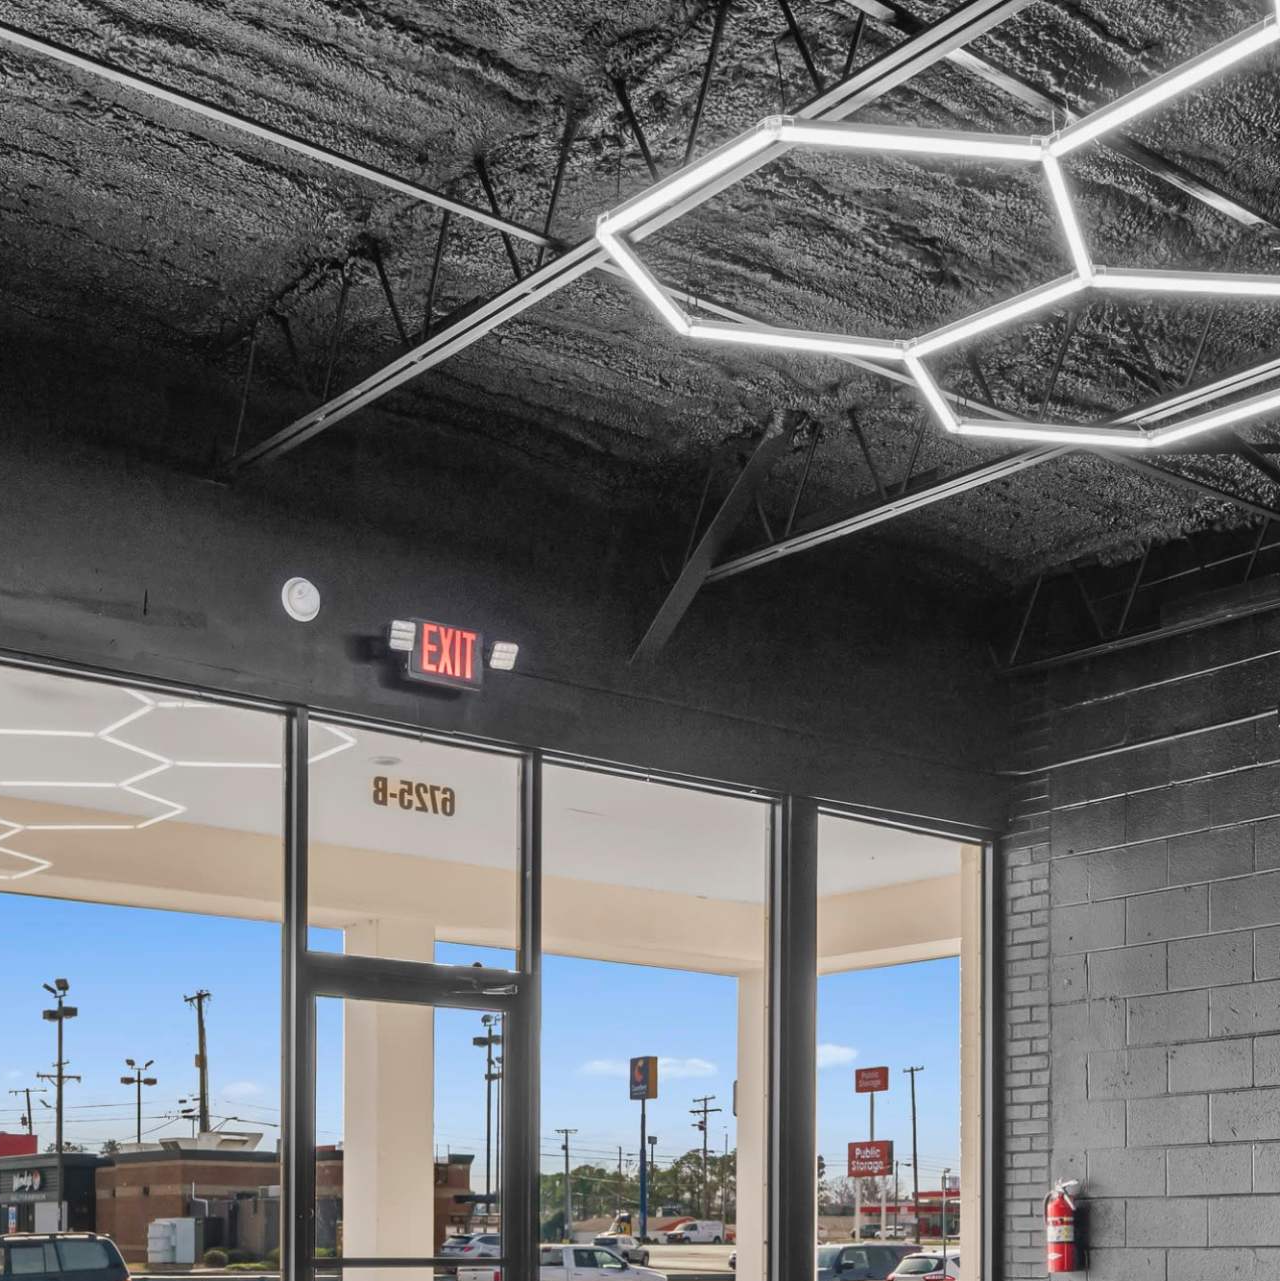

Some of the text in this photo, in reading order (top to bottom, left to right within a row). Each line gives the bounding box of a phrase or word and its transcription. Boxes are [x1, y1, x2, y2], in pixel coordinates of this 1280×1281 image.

[423, 623, 476, 679] EXIT
[855, 1147, 881, 1159] Public
[851, 1160, 884, 1174] Storage
